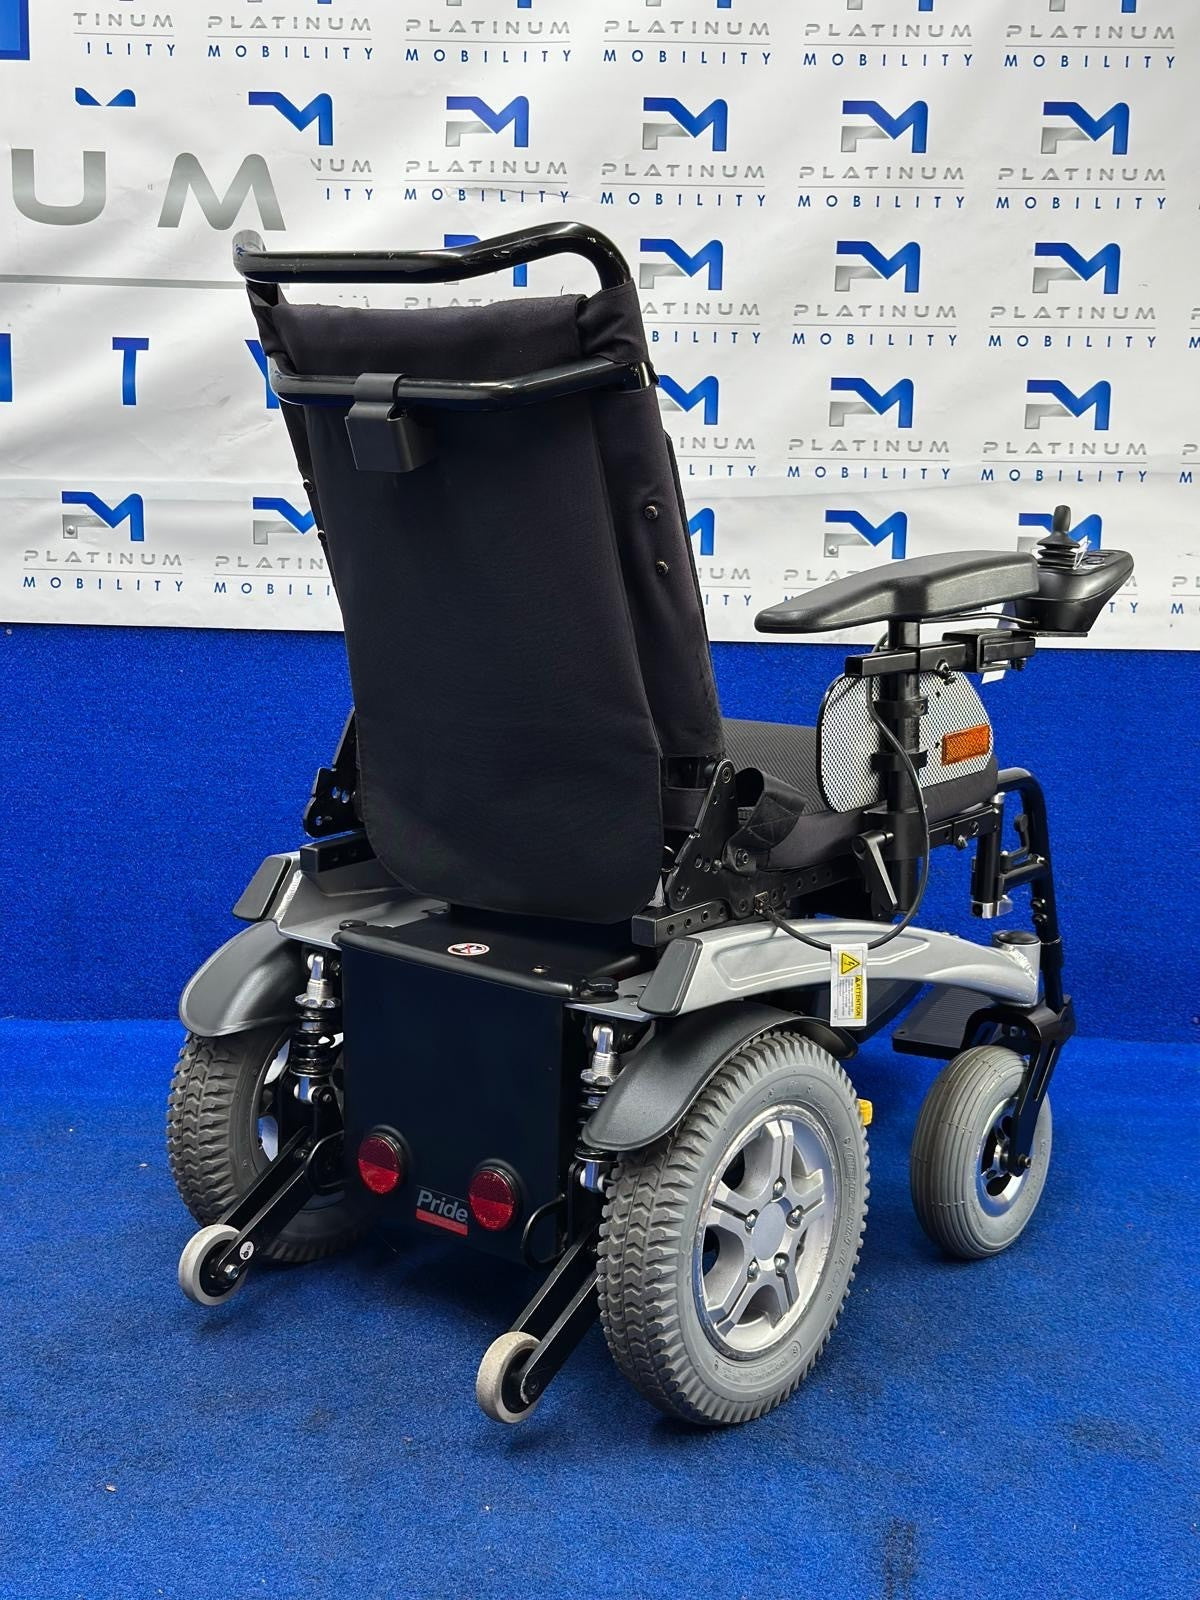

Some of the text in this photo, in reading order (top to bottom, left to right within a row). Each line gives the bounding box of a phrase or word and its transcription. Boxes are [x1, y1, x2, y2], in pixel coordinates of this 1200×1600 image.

[208, 16, 371, 34] PLATINUM
[406, 19, 570, 34] PLATINUM
[604, 20, 770, 36] PLATINUM
[805, 24, 972, 40] PLATINUM
[1006, 24, 1175, 39] PLATINUM
[208, 44, 373, 60] MOBILITY
[405, 48, 571, 64] MOBILITY
[603, 47, 772, 65] MOBILITY
[803, 51, 973, 67] MOBILITY
[1004, 53, 1175, 69] MOBILITY
[406, 160, 567, 177] PLATINUM
[602, 163, 765, 181] PLATINUM
[799, 166, 964, 183] PLATINUM
[998, 168, 1165, 184] PLATINUM
[404, 186, 572, 204] MOBILITY
[600, 192, 766, 207] MOBILITY
[797, 192, 965, 208] MOBILITY
[996, 195, 1166, 210] MOBILITY
[642, 302, 760, 316] ATINUM
[794, 304, 956, 318] PLATINUM
[990, 305, 1156, 320] PLATINUM
[652, 329, 760, 344] BILITY
[792, 330, 957, 348] MOBILITY
[988, 333, 1156, 349] MOBILITY
[680, 437, 755, 450] INUM
[788, 436, 949, 453] PLATINUM
[983, 441, 1147, 455] PLATINUM
[688, 464, 756, 477] LITY
[787, 464, 951, 480] MOBILITY
[981, 471, 1147, 483] MOBILITY
[24, 550, 182, 567] PLATINUM
[215, 553, 324, 570] PLATIN
[23, 577, 183, 592] MOBILITY
[214, 582, 330, 596] MOBILI
[416, 1189, 469, 1223] Pride
